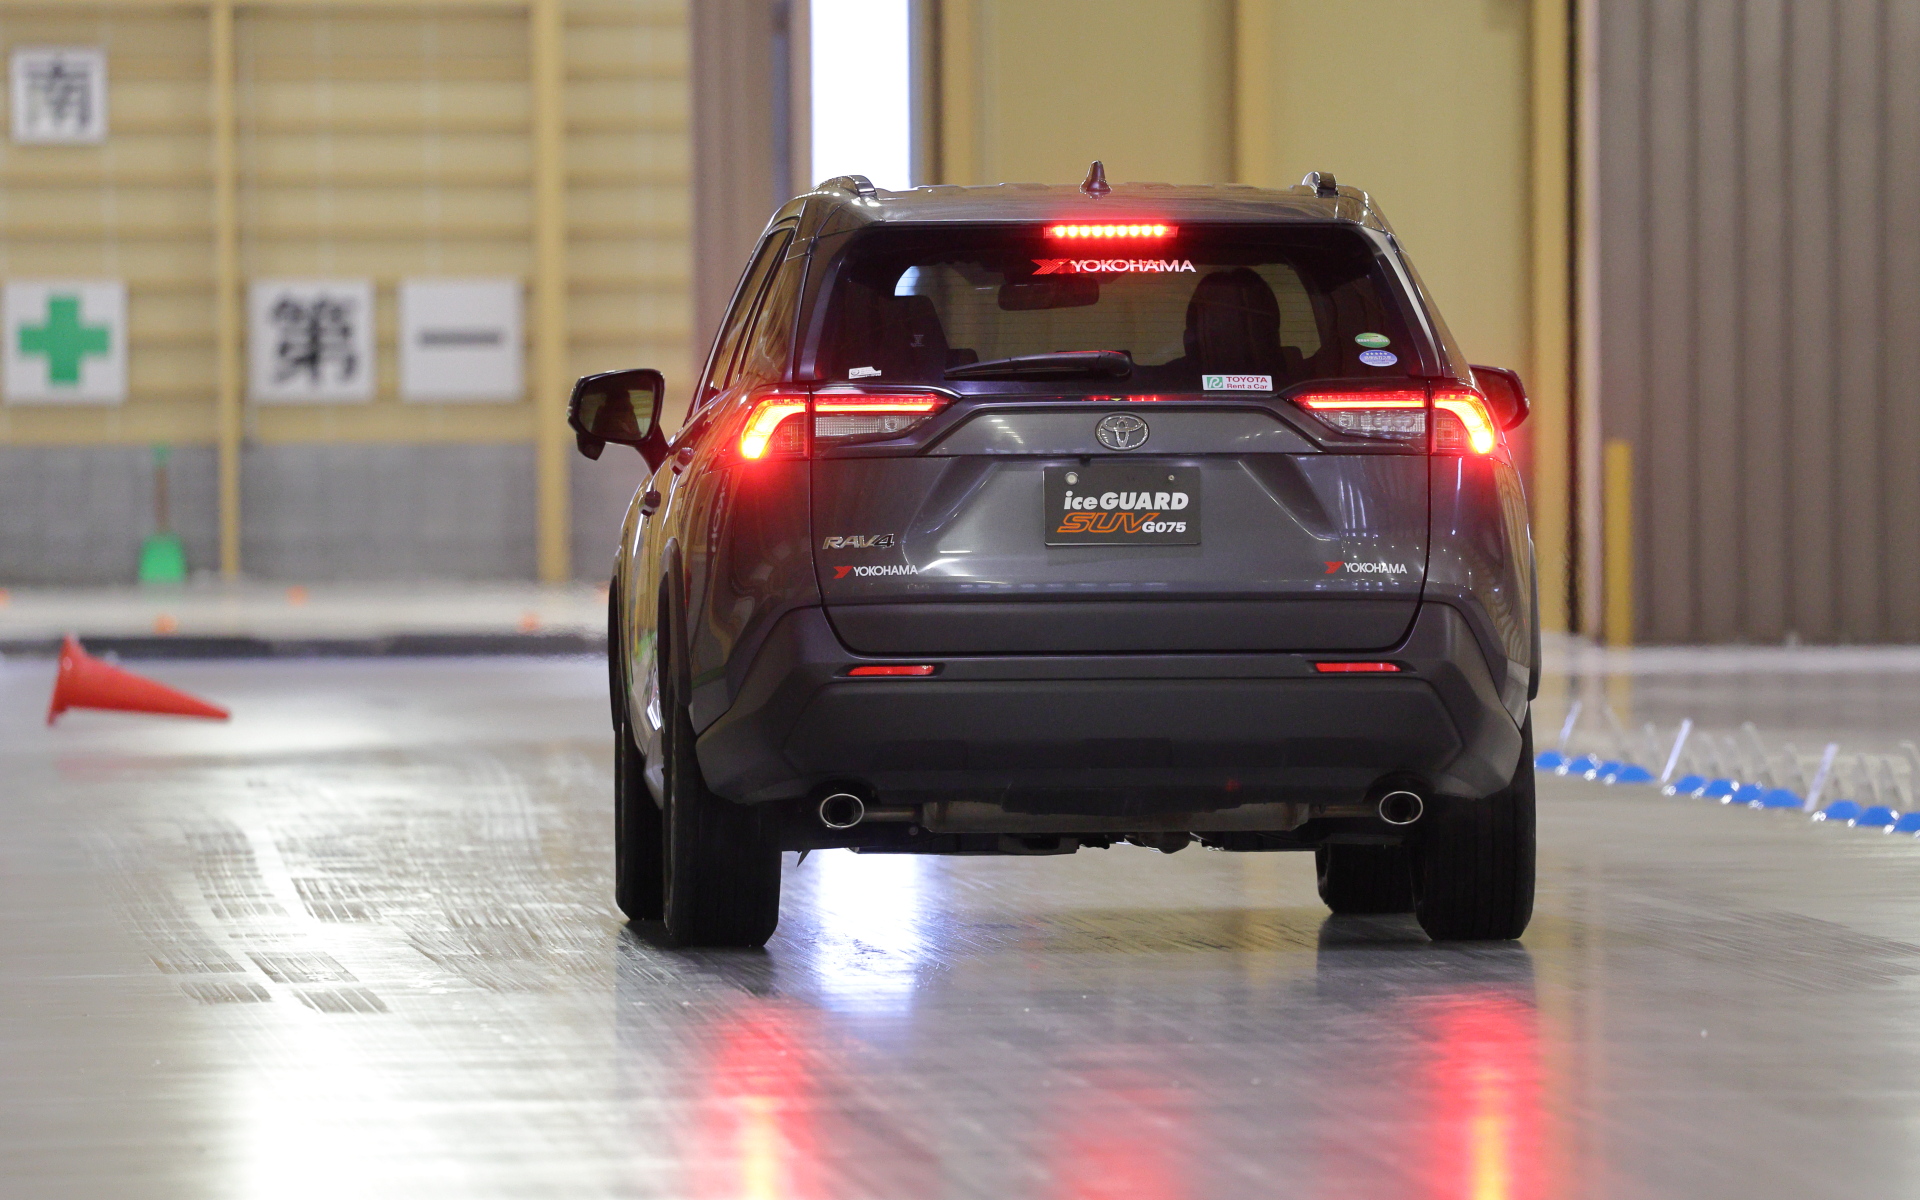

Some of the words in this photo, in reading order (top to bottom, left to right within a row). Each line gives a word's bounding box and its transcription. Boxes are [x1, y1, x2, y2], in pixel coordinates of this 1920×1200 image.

[23, 60, 92, 131] 南
[1070, 259, 1197, 273] YOKOHAMA
[1057, 512, 1160, 534] SUV
[1141, 521, 1187, 533] G075
[822, 533, 894, 549] RAV4
[853, 565, 919, 577] YOKOHAMA
[1344, 562, 1408, 574] YOKOHAMA
